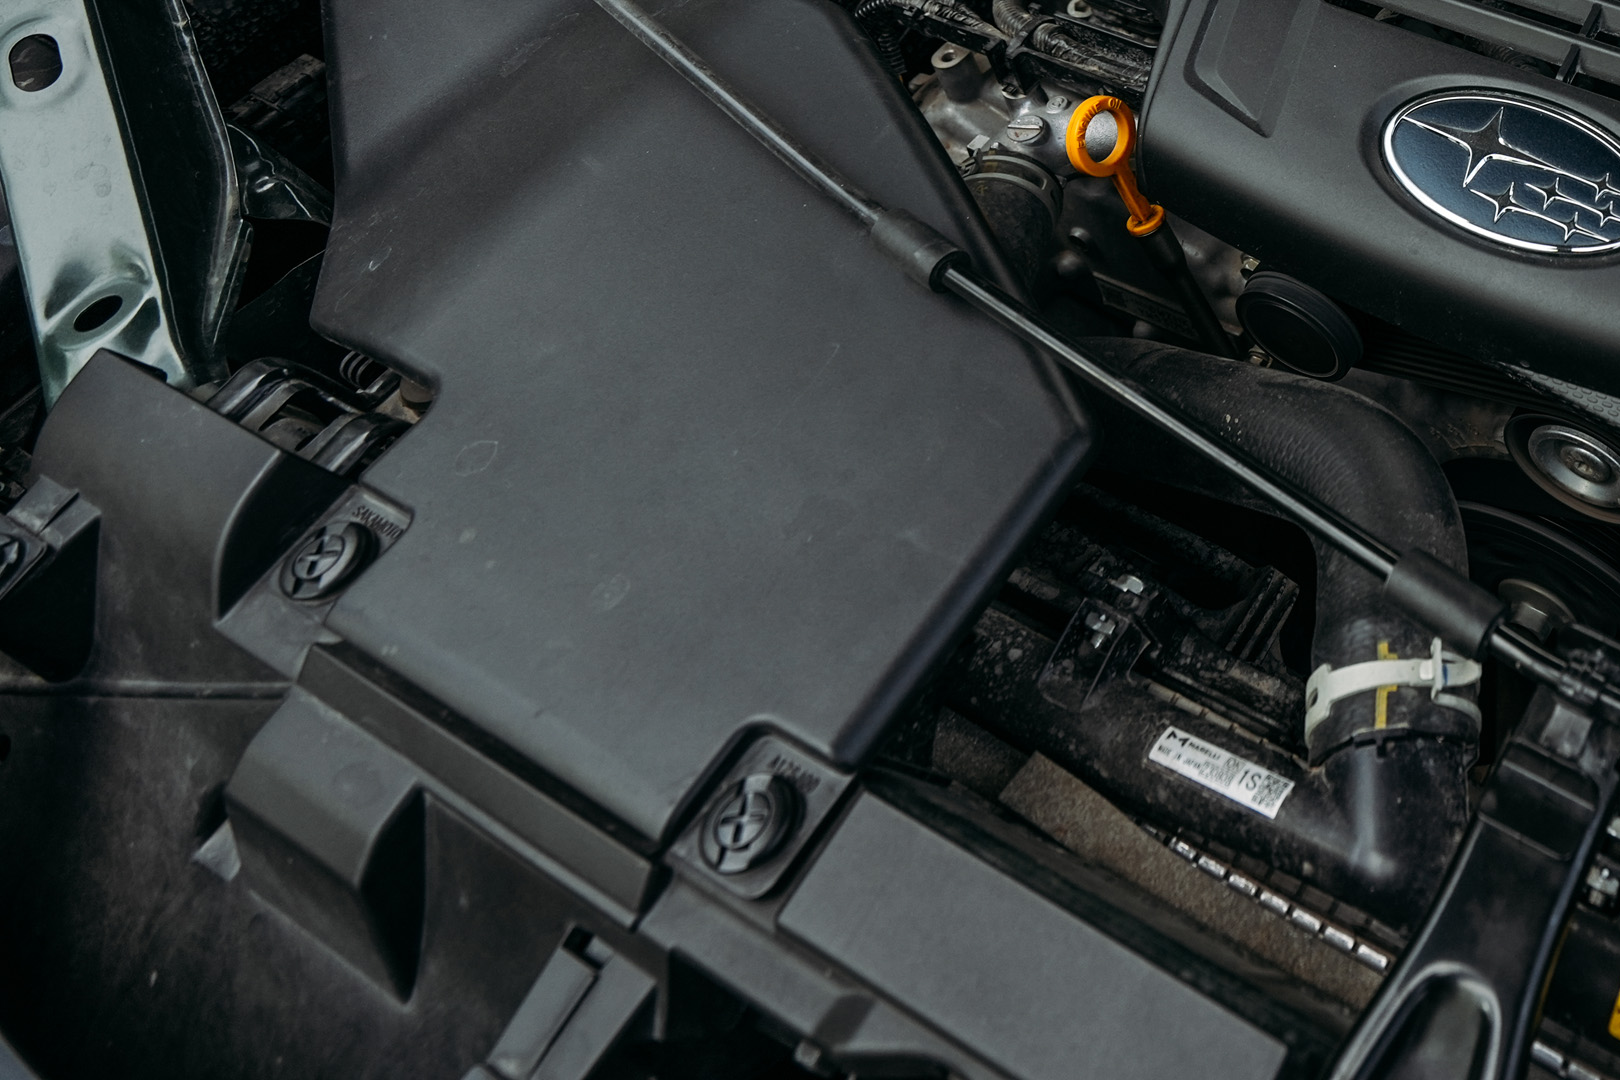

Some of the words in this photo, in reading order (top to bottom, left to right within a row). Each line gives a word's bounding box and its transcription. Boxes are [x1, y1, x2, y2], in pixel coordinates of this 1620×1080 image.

[1076, 101, 1101, 149] ENGINE
[1107, 98, 1122, 109] OIL
[352, 503, 404, 540] SAKAMOTO
